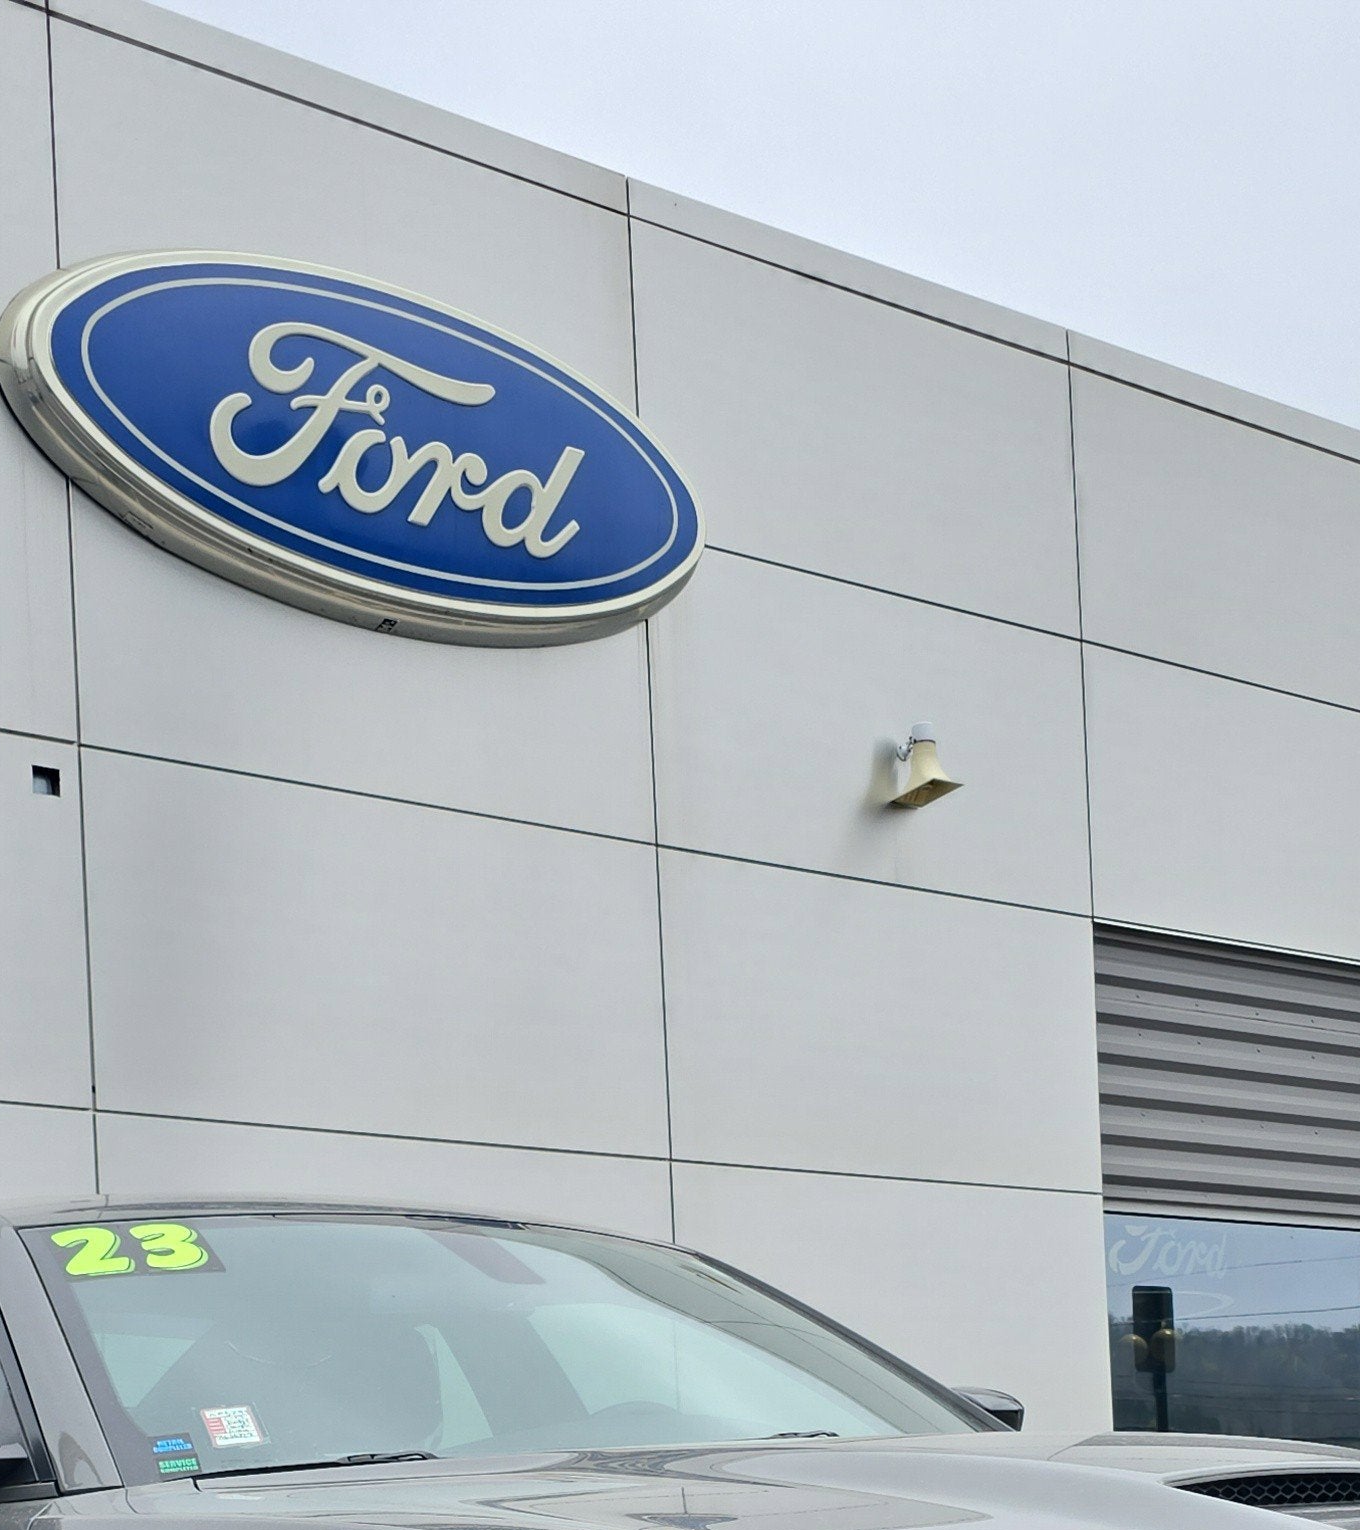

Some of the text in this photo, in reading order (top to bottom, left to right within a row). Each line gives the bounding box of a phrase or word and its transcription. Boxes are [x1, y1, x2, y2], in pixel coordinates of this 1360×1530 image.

[210, 321, 585, 558] Ford
[51, 1223, 209, 1276] 23
[159, 1458, 197, 1469] SERVICE
